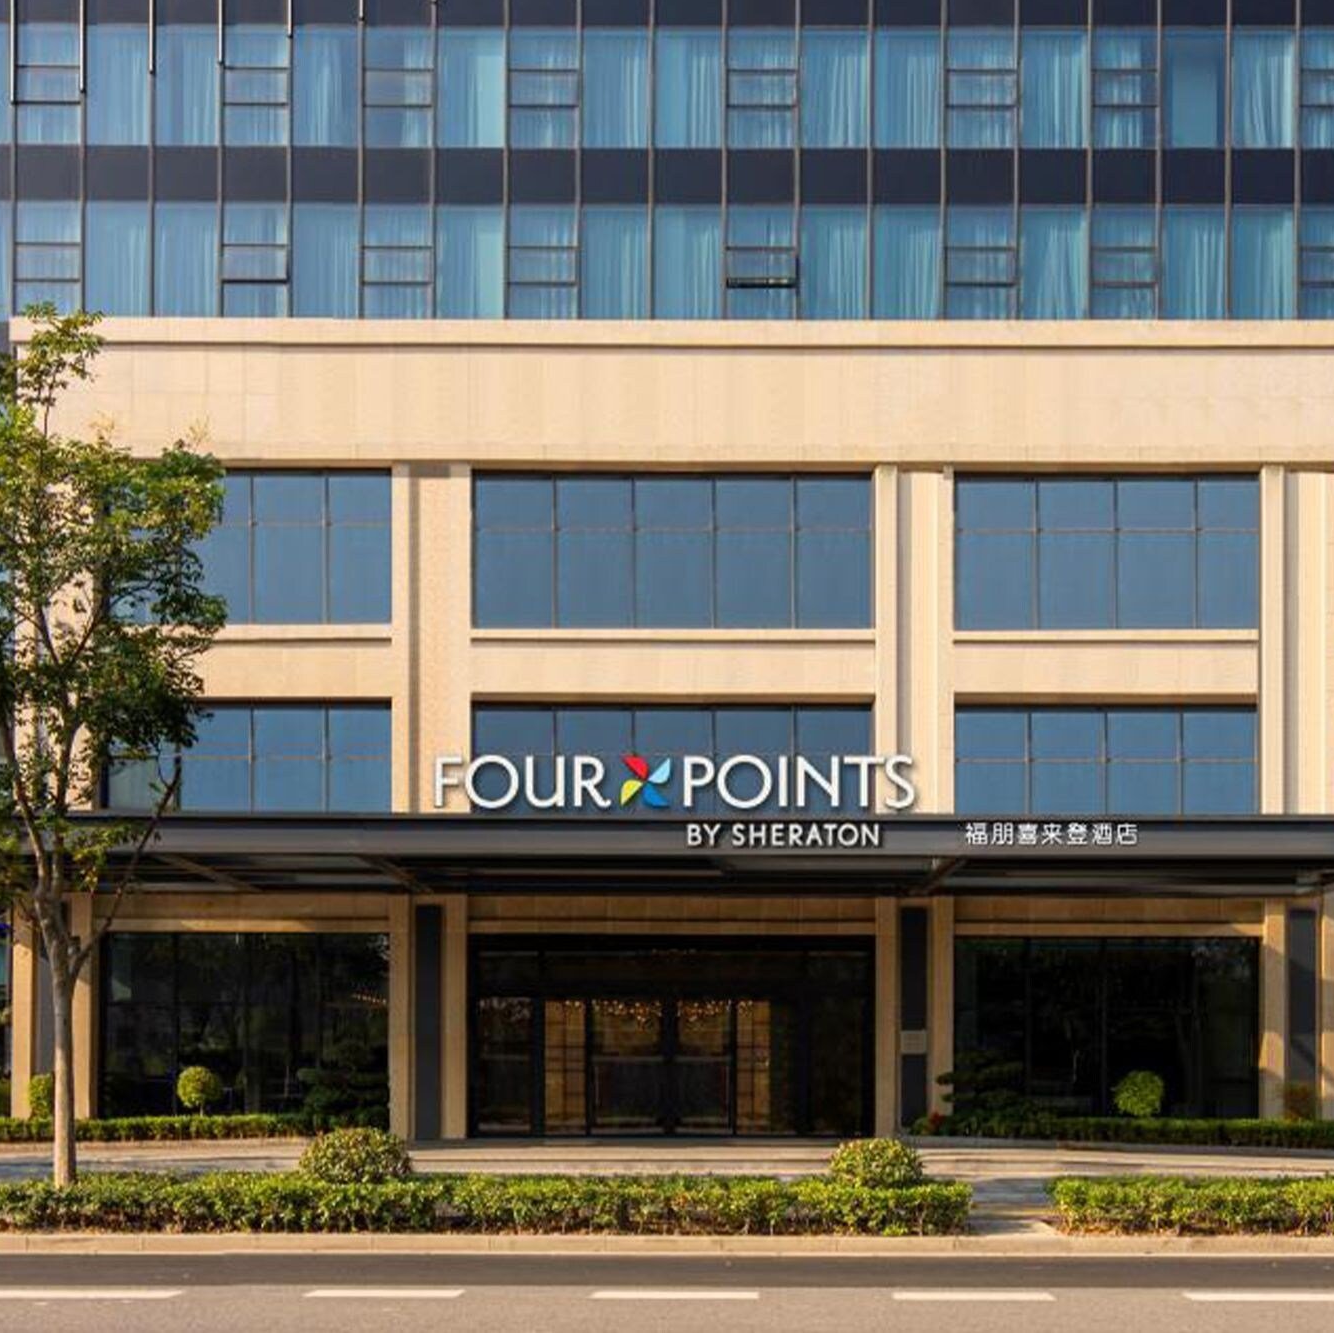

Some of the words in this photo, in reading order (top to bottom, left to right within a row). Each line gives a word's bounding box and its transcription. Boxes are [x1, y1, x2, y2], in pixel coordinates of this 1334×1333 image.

[434, 755, 612, 809] FOUR
[683, 755, 915, 809] POINTS
[687, 824, 720, 846] BY
[733, 823, 880, 846] SHERATON
[965, 821, 1138, 846] 福朋喜来登酒店
